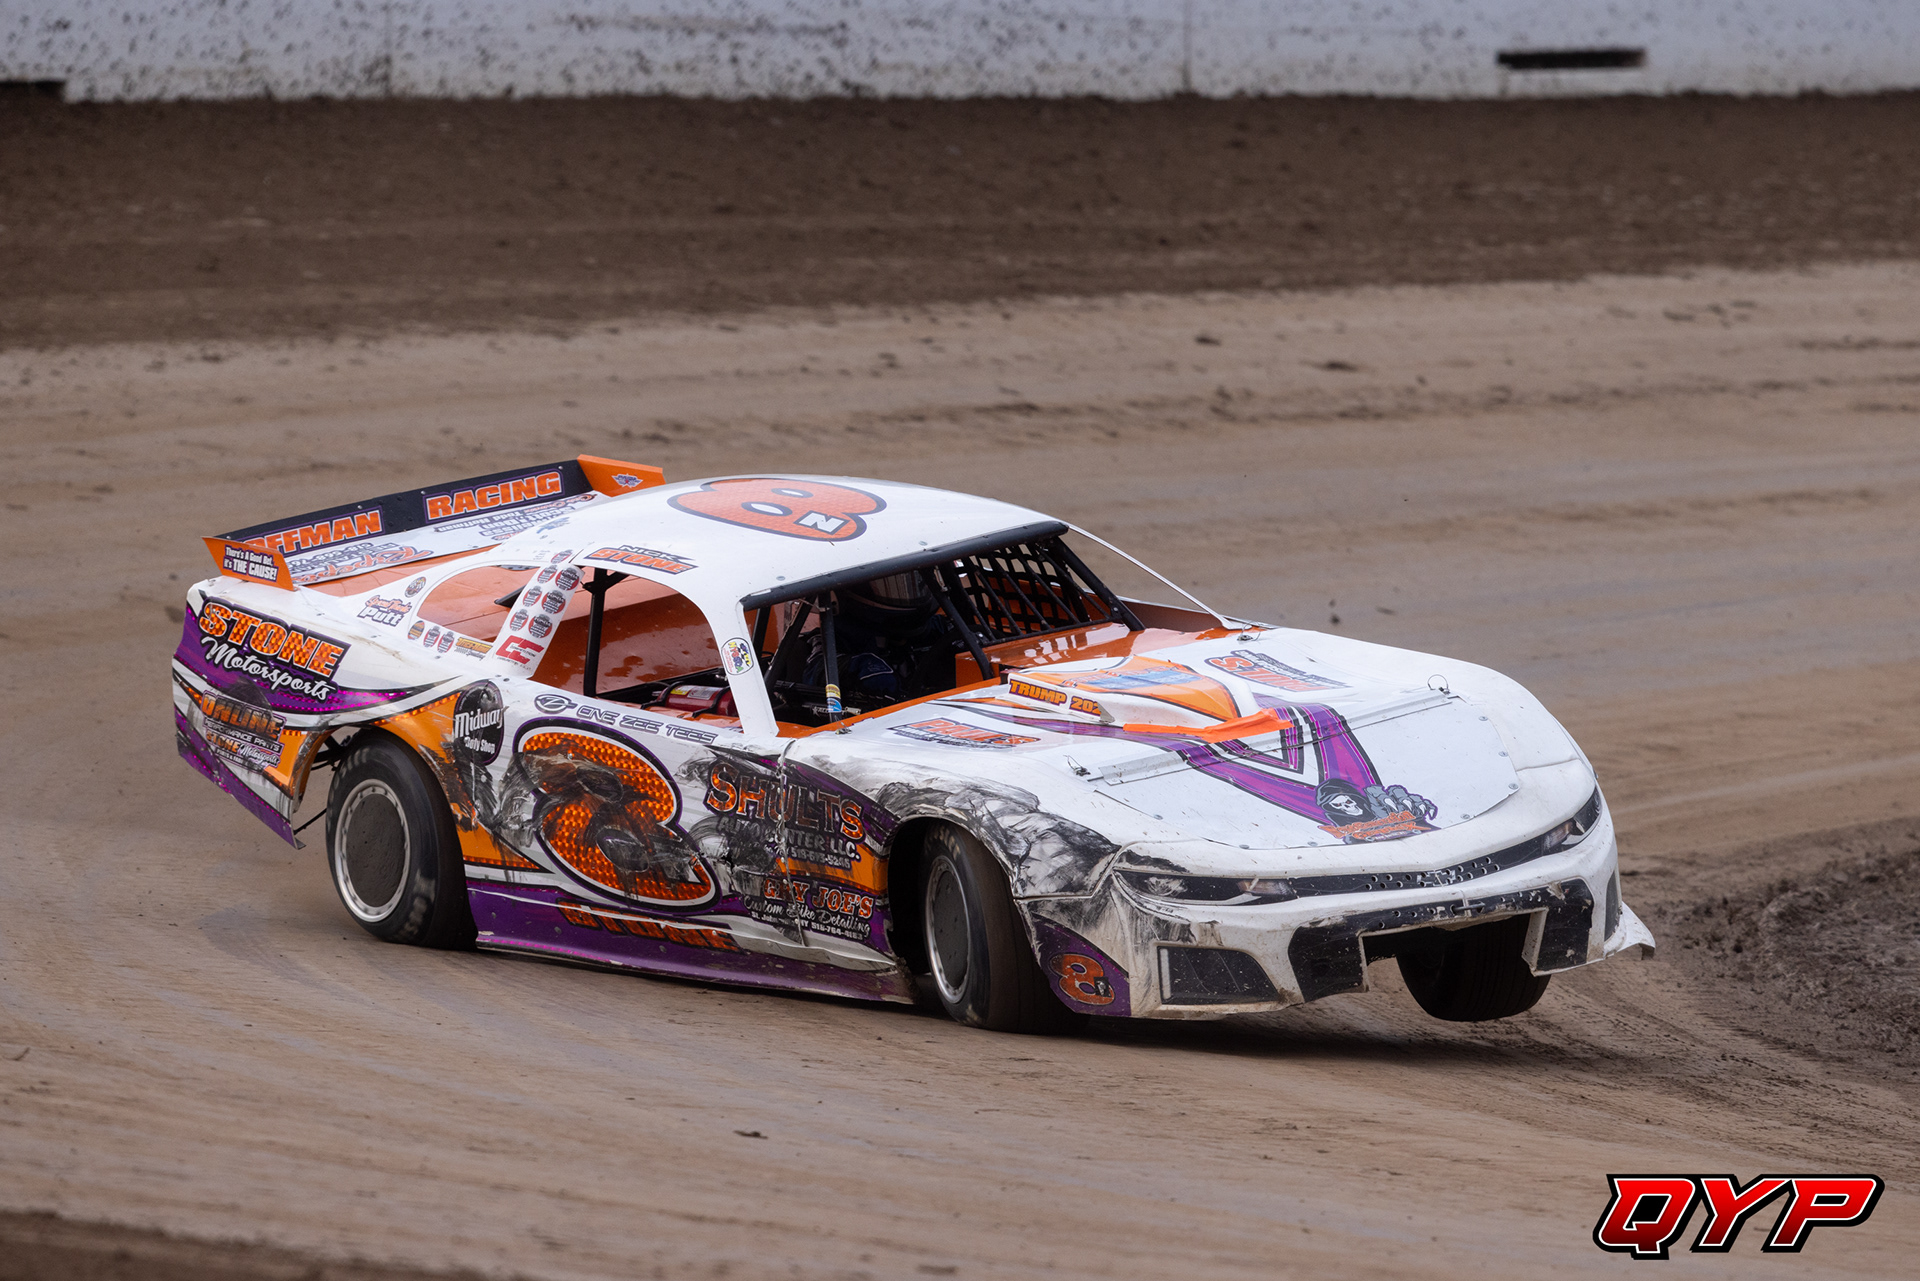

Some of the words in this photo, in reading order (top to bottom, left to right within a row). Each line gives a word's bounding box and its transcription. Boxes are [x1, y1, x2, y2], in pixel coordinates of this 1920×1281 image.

[426, 471, 562, 520] RACING
[233, 559, 247, 573] THE
[248, 562, 278, 580] CAUSE!
[588, 549, 694, 574] STONE
[619, 545, 680, 562] NICK
[199, 602, 345, 678] STONE
[201, 636, 336, 701] Motorsports
[1207, 656, 1330, 691] PAUL'S
[1010, 680, 1067, 705] TRUMP
[454, 708, 503, 738] Midway
[577, 705, 620, 725] ONE
[620, 715, 664, 734] ZEE
[665, 724, 719, 744] TEES
[480, 738, 495, 755] Shop
[707, 763, 864, 840] SHULTS
[812, 885, 874, 919] JOE'S
[817, 908, 871, 937] Detailing
[1050, 953, 1115, 1006] 8
